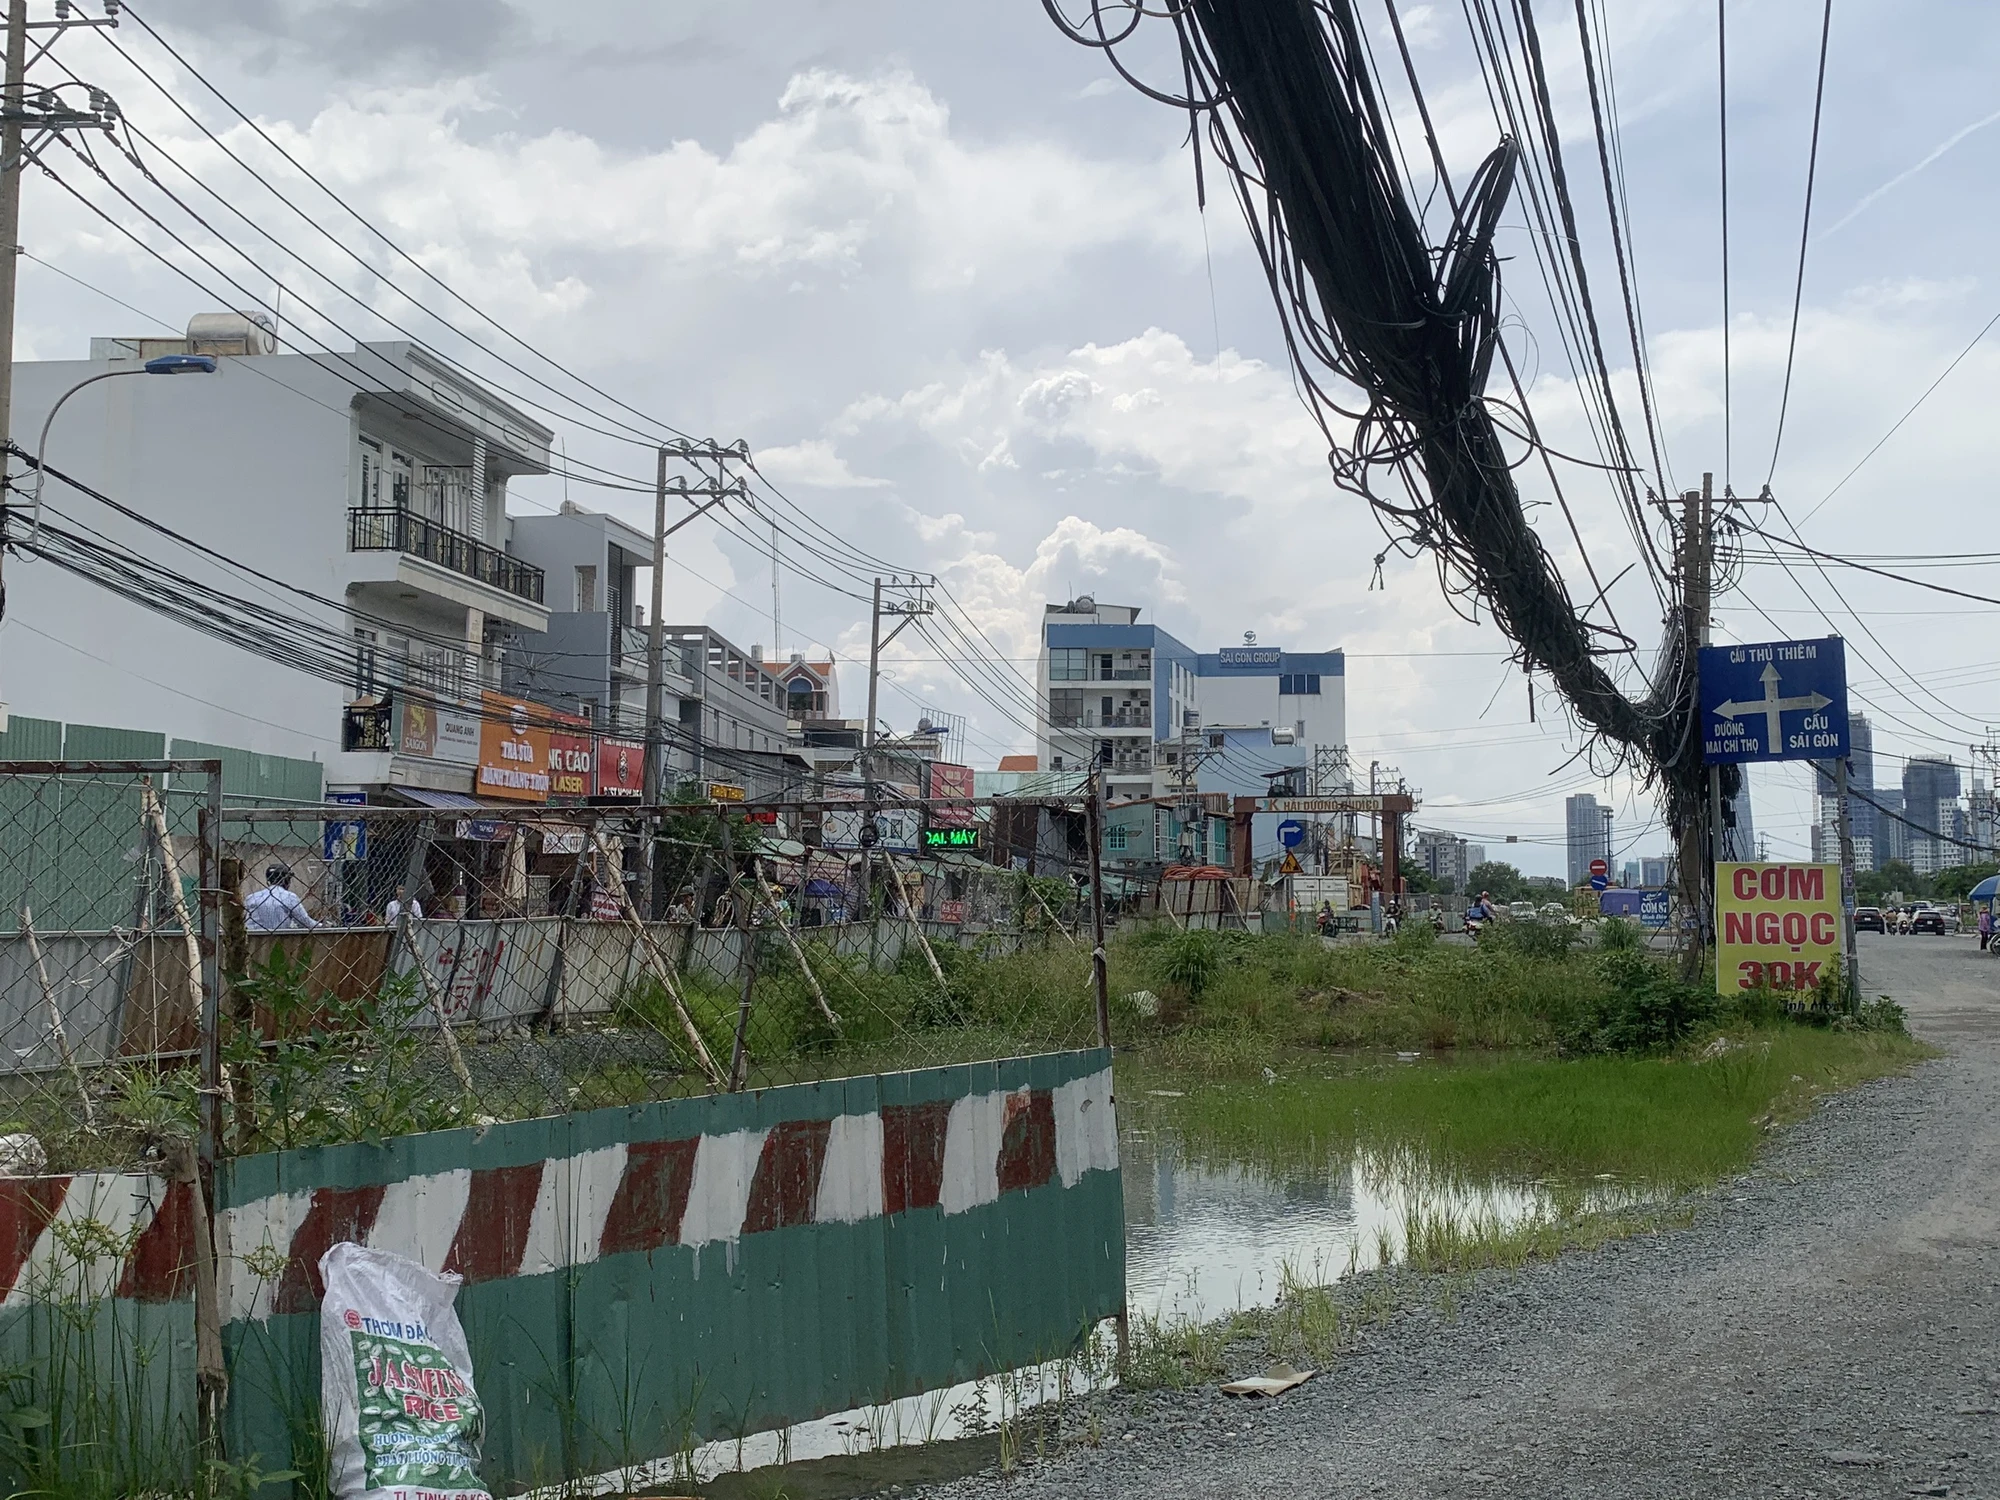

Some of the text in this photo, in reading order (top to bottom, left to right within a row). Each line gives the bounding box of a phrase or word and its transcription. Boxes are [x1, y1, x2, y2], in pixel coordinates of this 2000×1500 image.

[1253, 652, 1280, 663] GROUP
[1749, 644, 1773, 661] THỦ
[1777, 644, 1816, 660] THIÊM
[445, 723, 475, 737] QUANG ANH
[1714, 721, 1744, 737] ĐƯỜNG
[1804, 714, 1828, 730] CẦU
[1706, 738, 1758, 754] MAI CHÍ THỌ
[1789, 731, 1838, 748] SÀI GÒN
[565, 745, 590, 773] CÁO
[553, 776, 583, 793] LASER
[1733, 865, 1824, 901] CƠM
[1725, 912, 1836, 953] NGỌC
[1738, 961, 1823, 990] 30K
[361, 1317, 403, 1338] THƠM
[403, 1393, 463, 1422] RICE
